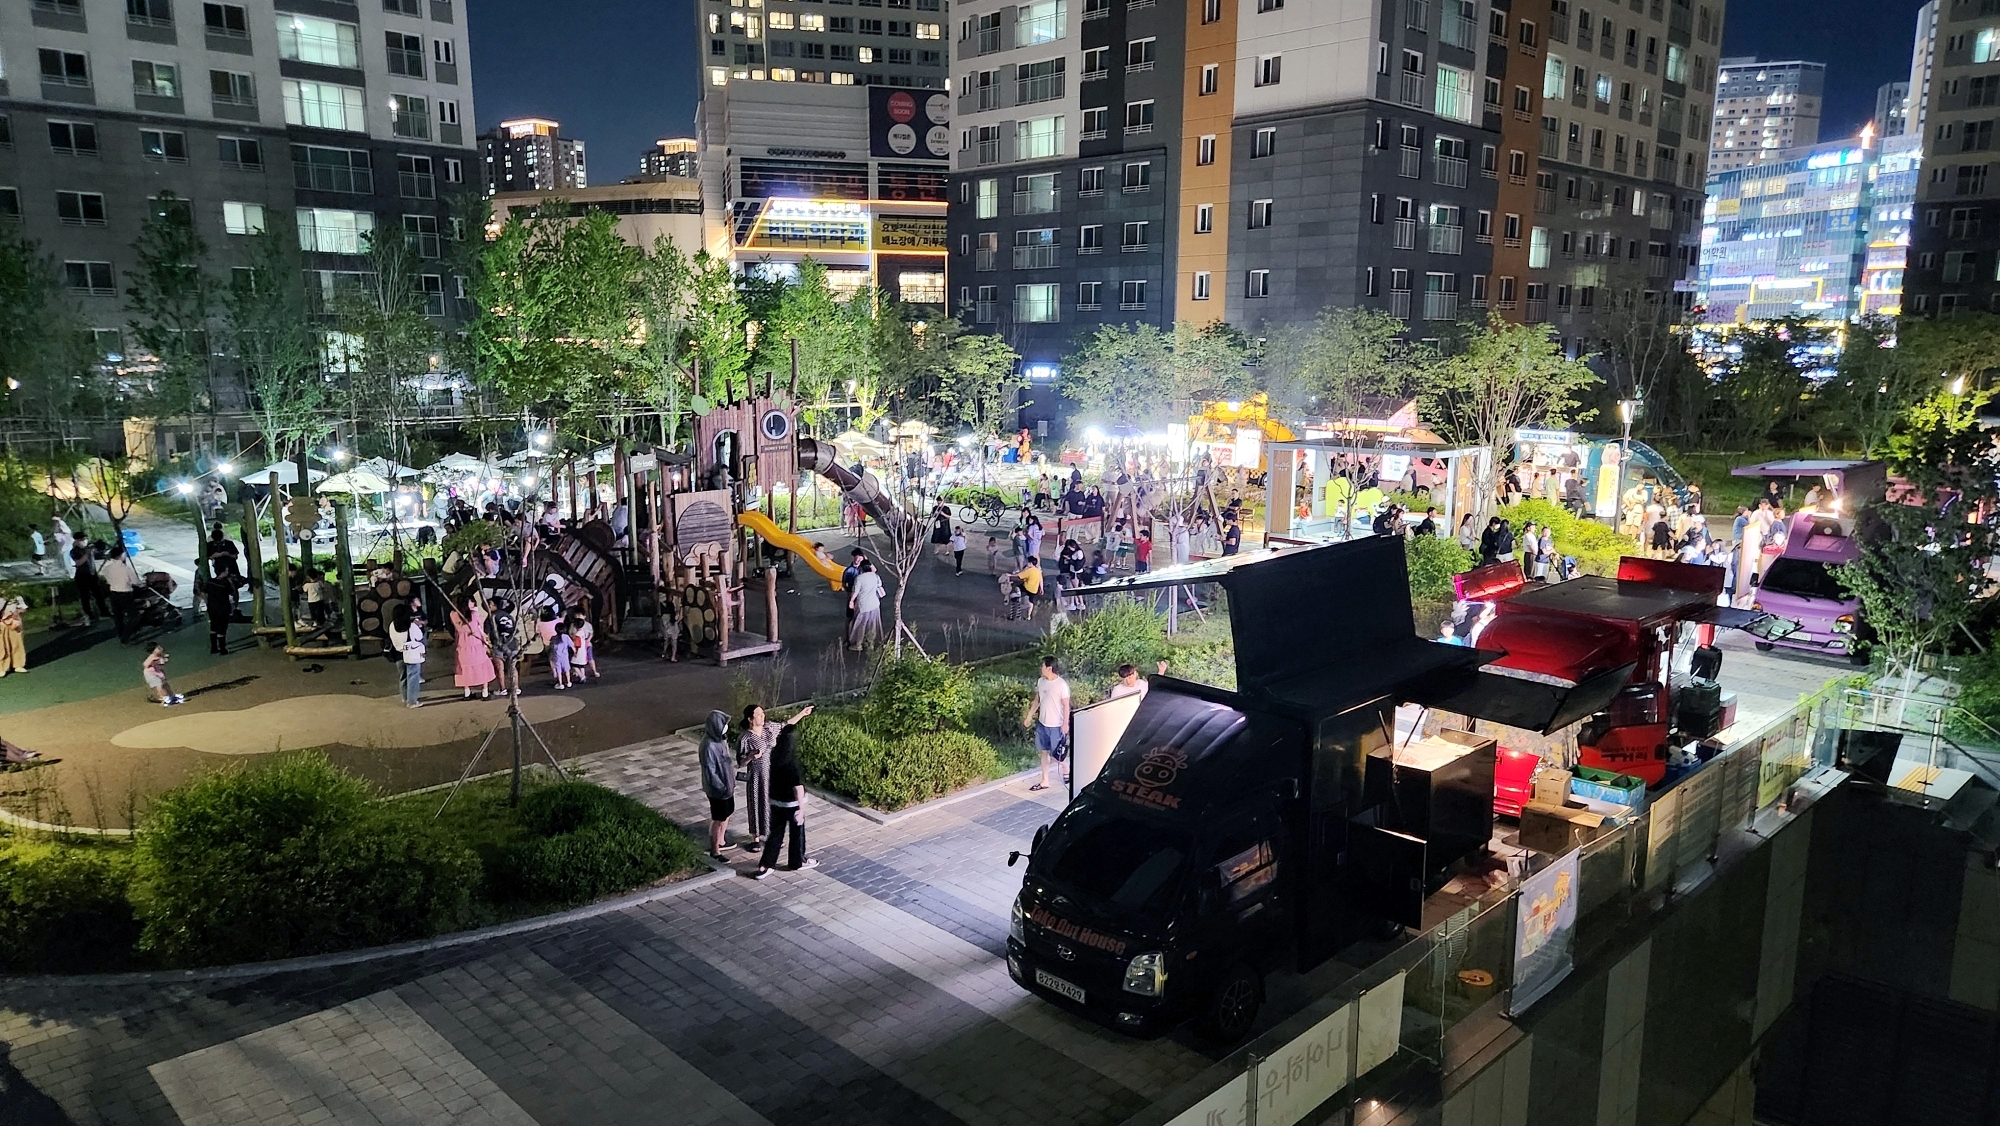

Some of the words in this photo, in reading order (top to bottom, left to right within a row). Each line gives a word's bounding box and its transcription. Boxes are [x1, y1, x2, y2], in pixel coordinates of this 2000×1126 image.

[890, 100, 913, 108] COMING
[1111, 780, 1182, 809] STEAK
[1031, 903, 1057, 928] Take
[1056, 918, 1082, 941] Out
[1079, 927, 1127, 956] House
